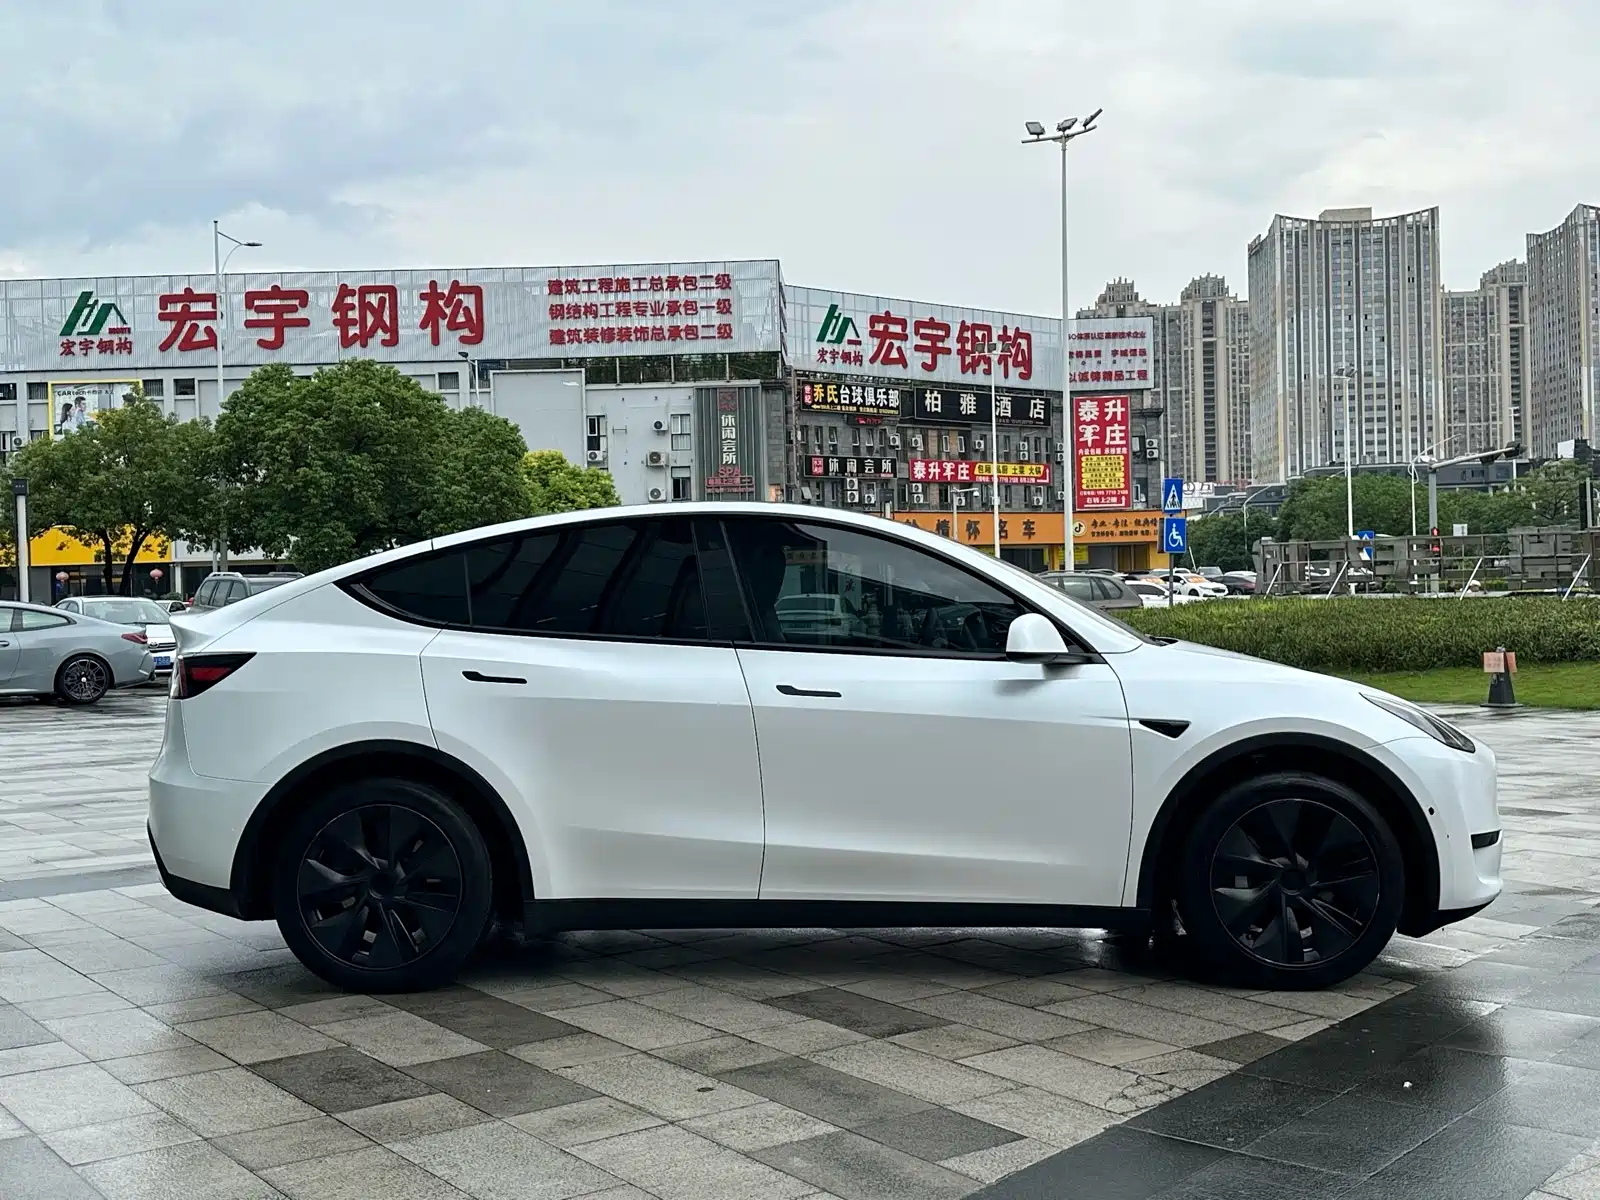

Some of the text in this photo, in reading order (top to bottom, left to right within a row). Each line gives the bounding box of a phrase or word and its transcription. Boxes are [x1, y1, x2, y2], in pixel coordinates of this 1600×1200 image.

[548, 273, 732, 296] 建筑工程施工总承包二级
[158, 279, 485, 353] 宏宇钢构
[548, 298, 733, 320] 钢结构工程专业承包一级
[549, 322, 734, 346] 建筑装修装饰总承包二级
[868, 310, 1033, 381] 宏宇钢构
[60, 337, 133, 357] 宏宇钢构
[816, 348, 864, 368] 宏宇钢构
[813, 383, 900, 408] 乔氏台球俱乐部
[925, 389, 1045, 420] 柏雅酒店
[1078, 399, 1126, 423] 泰升
[721, 414, 737, 465] 休闲会所
[1078, 422, 1127, 447] 羊庄
[829, 458, 892, 474] 休闲会所
[913, 461, 970, 481] 泰升羊庄
